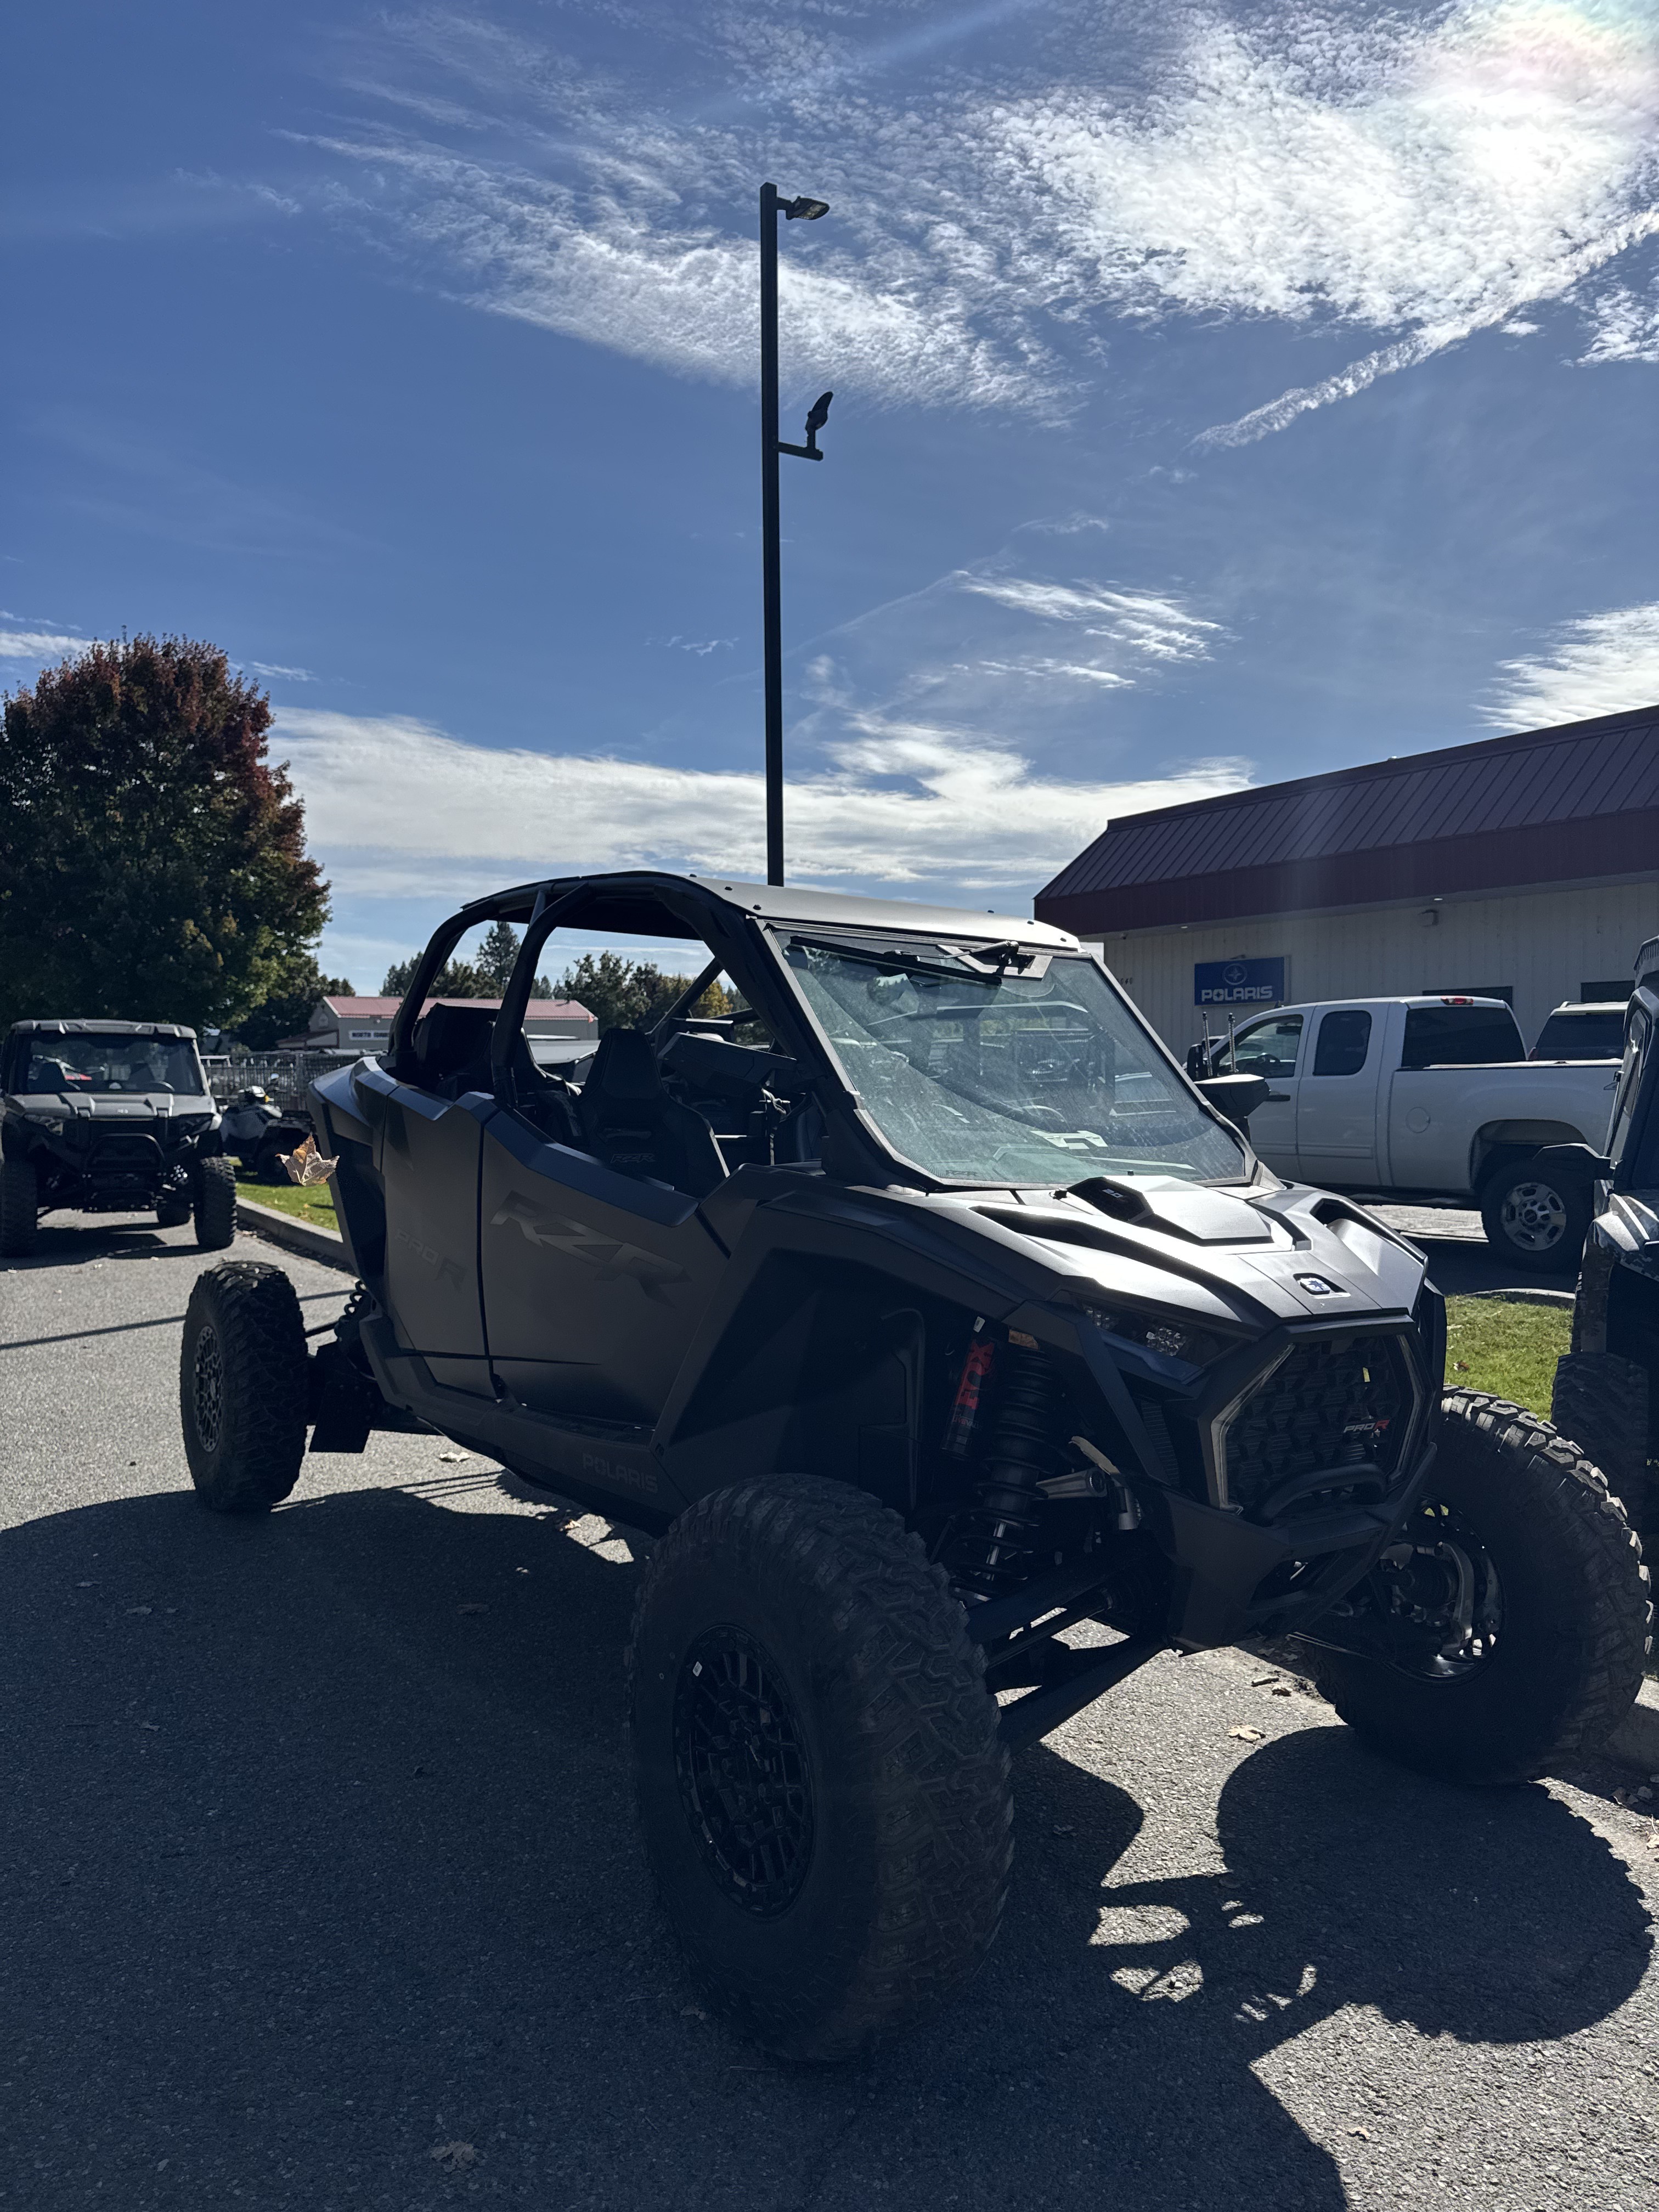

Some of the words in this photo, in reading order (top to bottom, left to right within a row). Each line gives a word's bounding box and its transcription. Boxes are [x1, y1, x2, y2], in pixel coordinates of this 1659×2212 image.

[1201, 986, 1273, 1002] POLARIS
[955, 1339, 995, 1410] FOX
[583, 1453, 658, 1493] POLARIS
